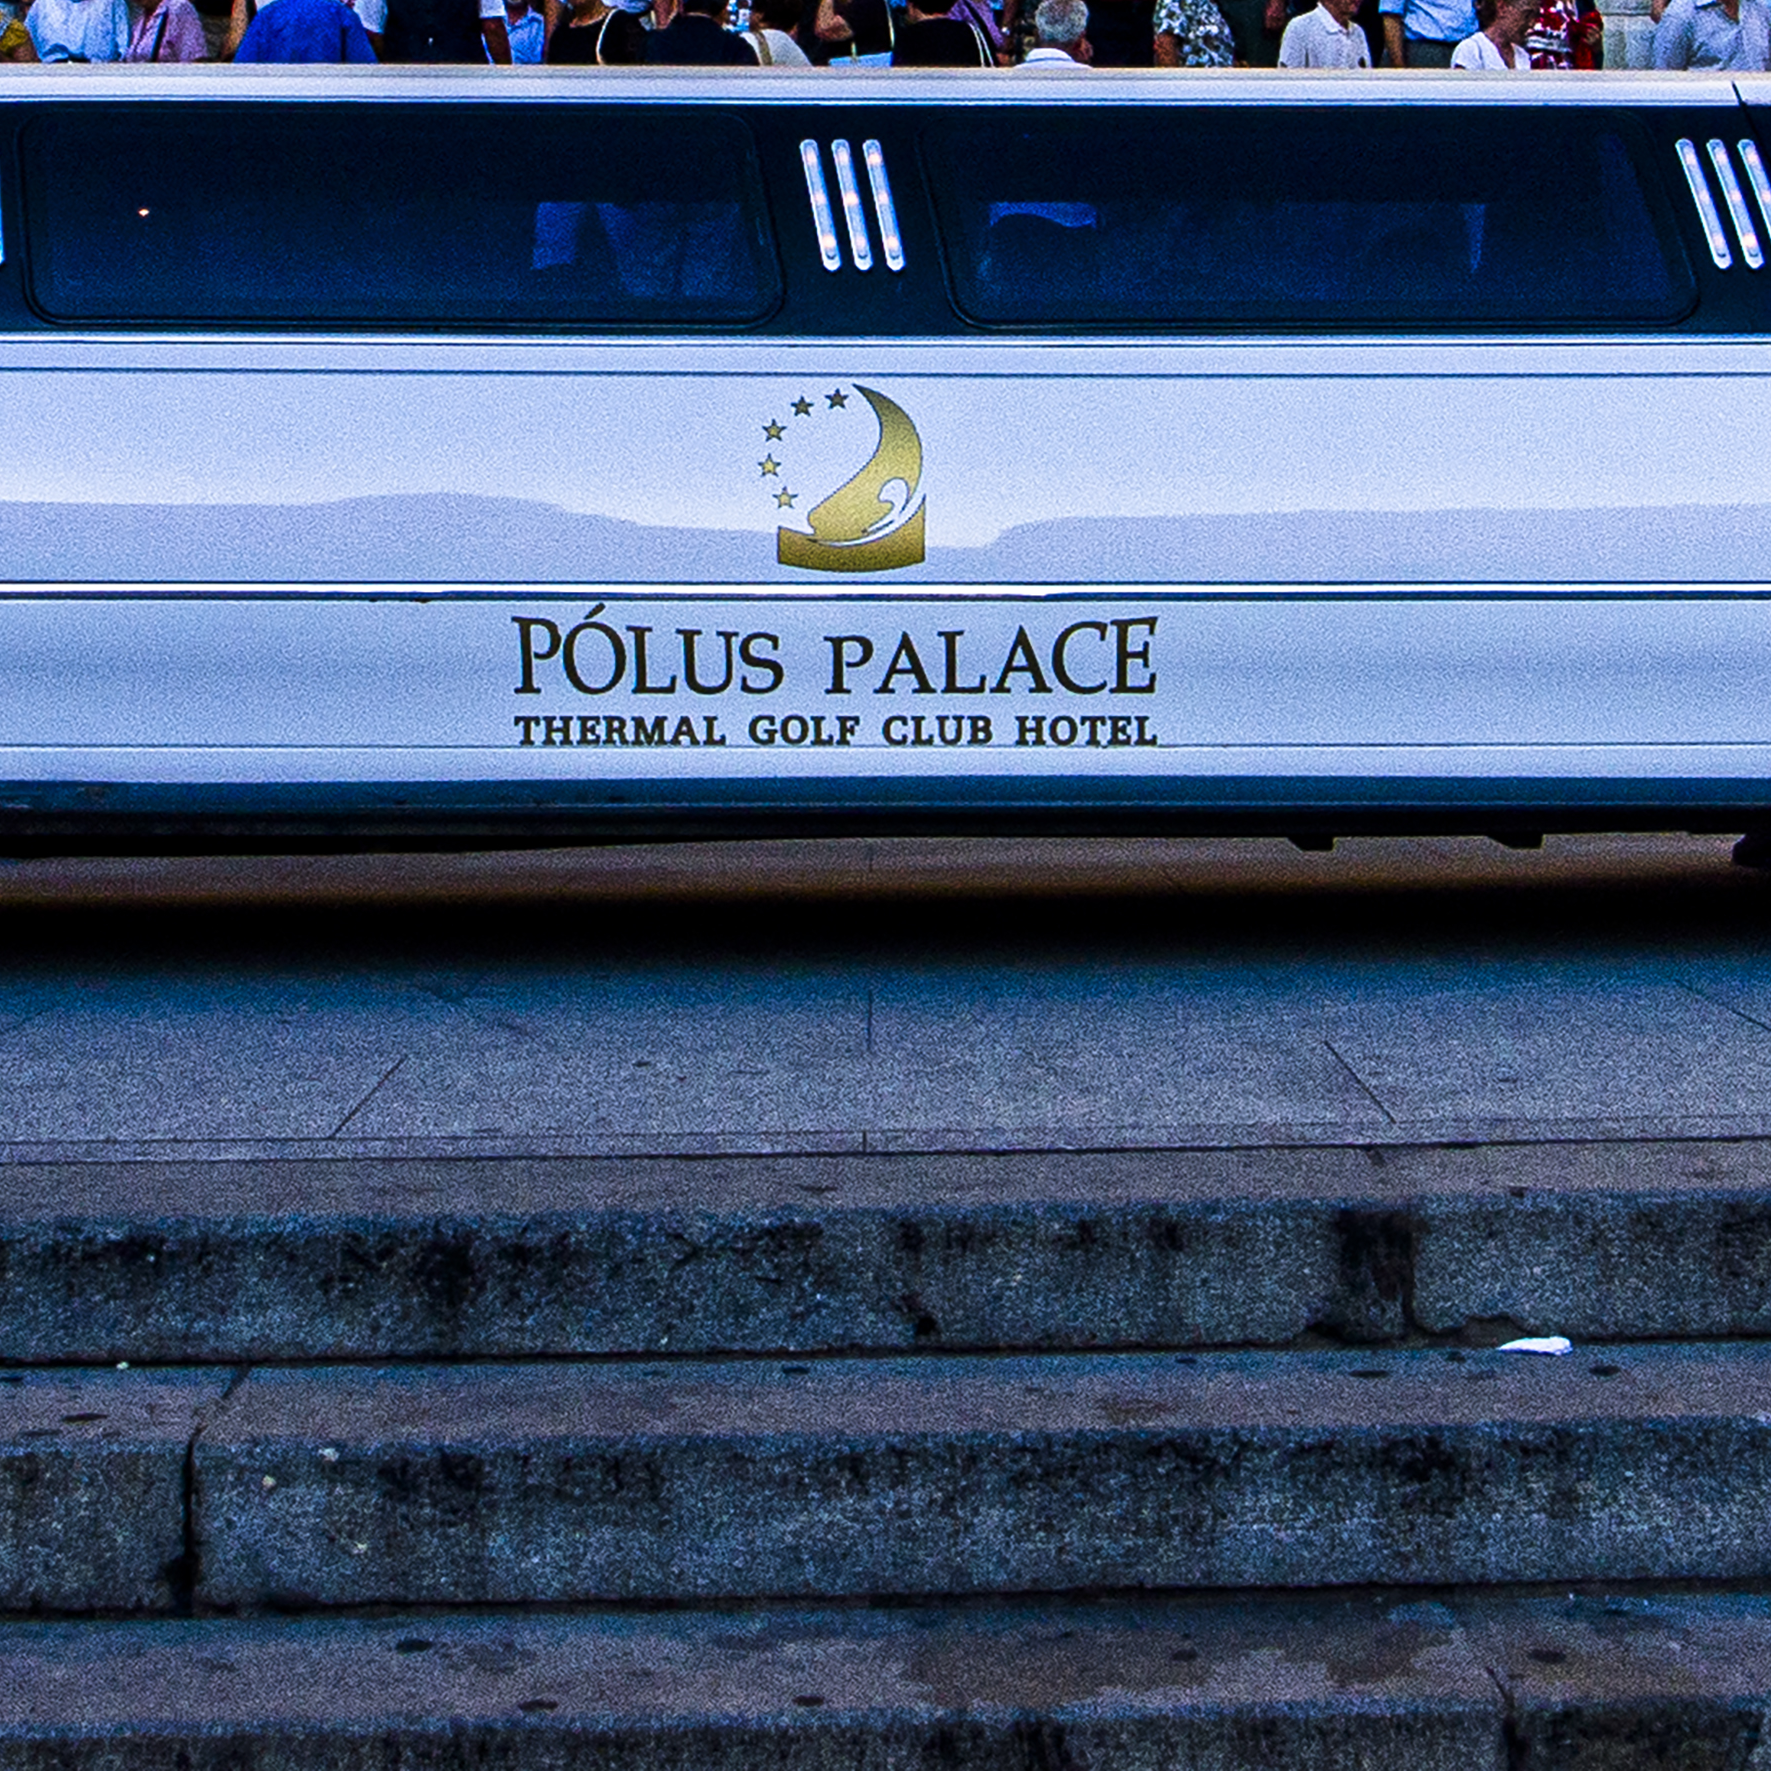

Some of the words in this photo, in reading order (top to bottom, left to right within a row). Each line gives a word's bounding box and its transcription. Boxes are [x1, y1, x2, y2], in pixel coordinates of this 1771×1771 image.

[511, 602, 785, 695] PÓLUS
[823, 616, 1159, 694] PALACE
[514, 714, 727, 746] THERMAL
[747, 714, 861, 746] GOLF
[881, 714, 993, 746] CLUB
[1015, 714, 1159, 746] HOTEL
